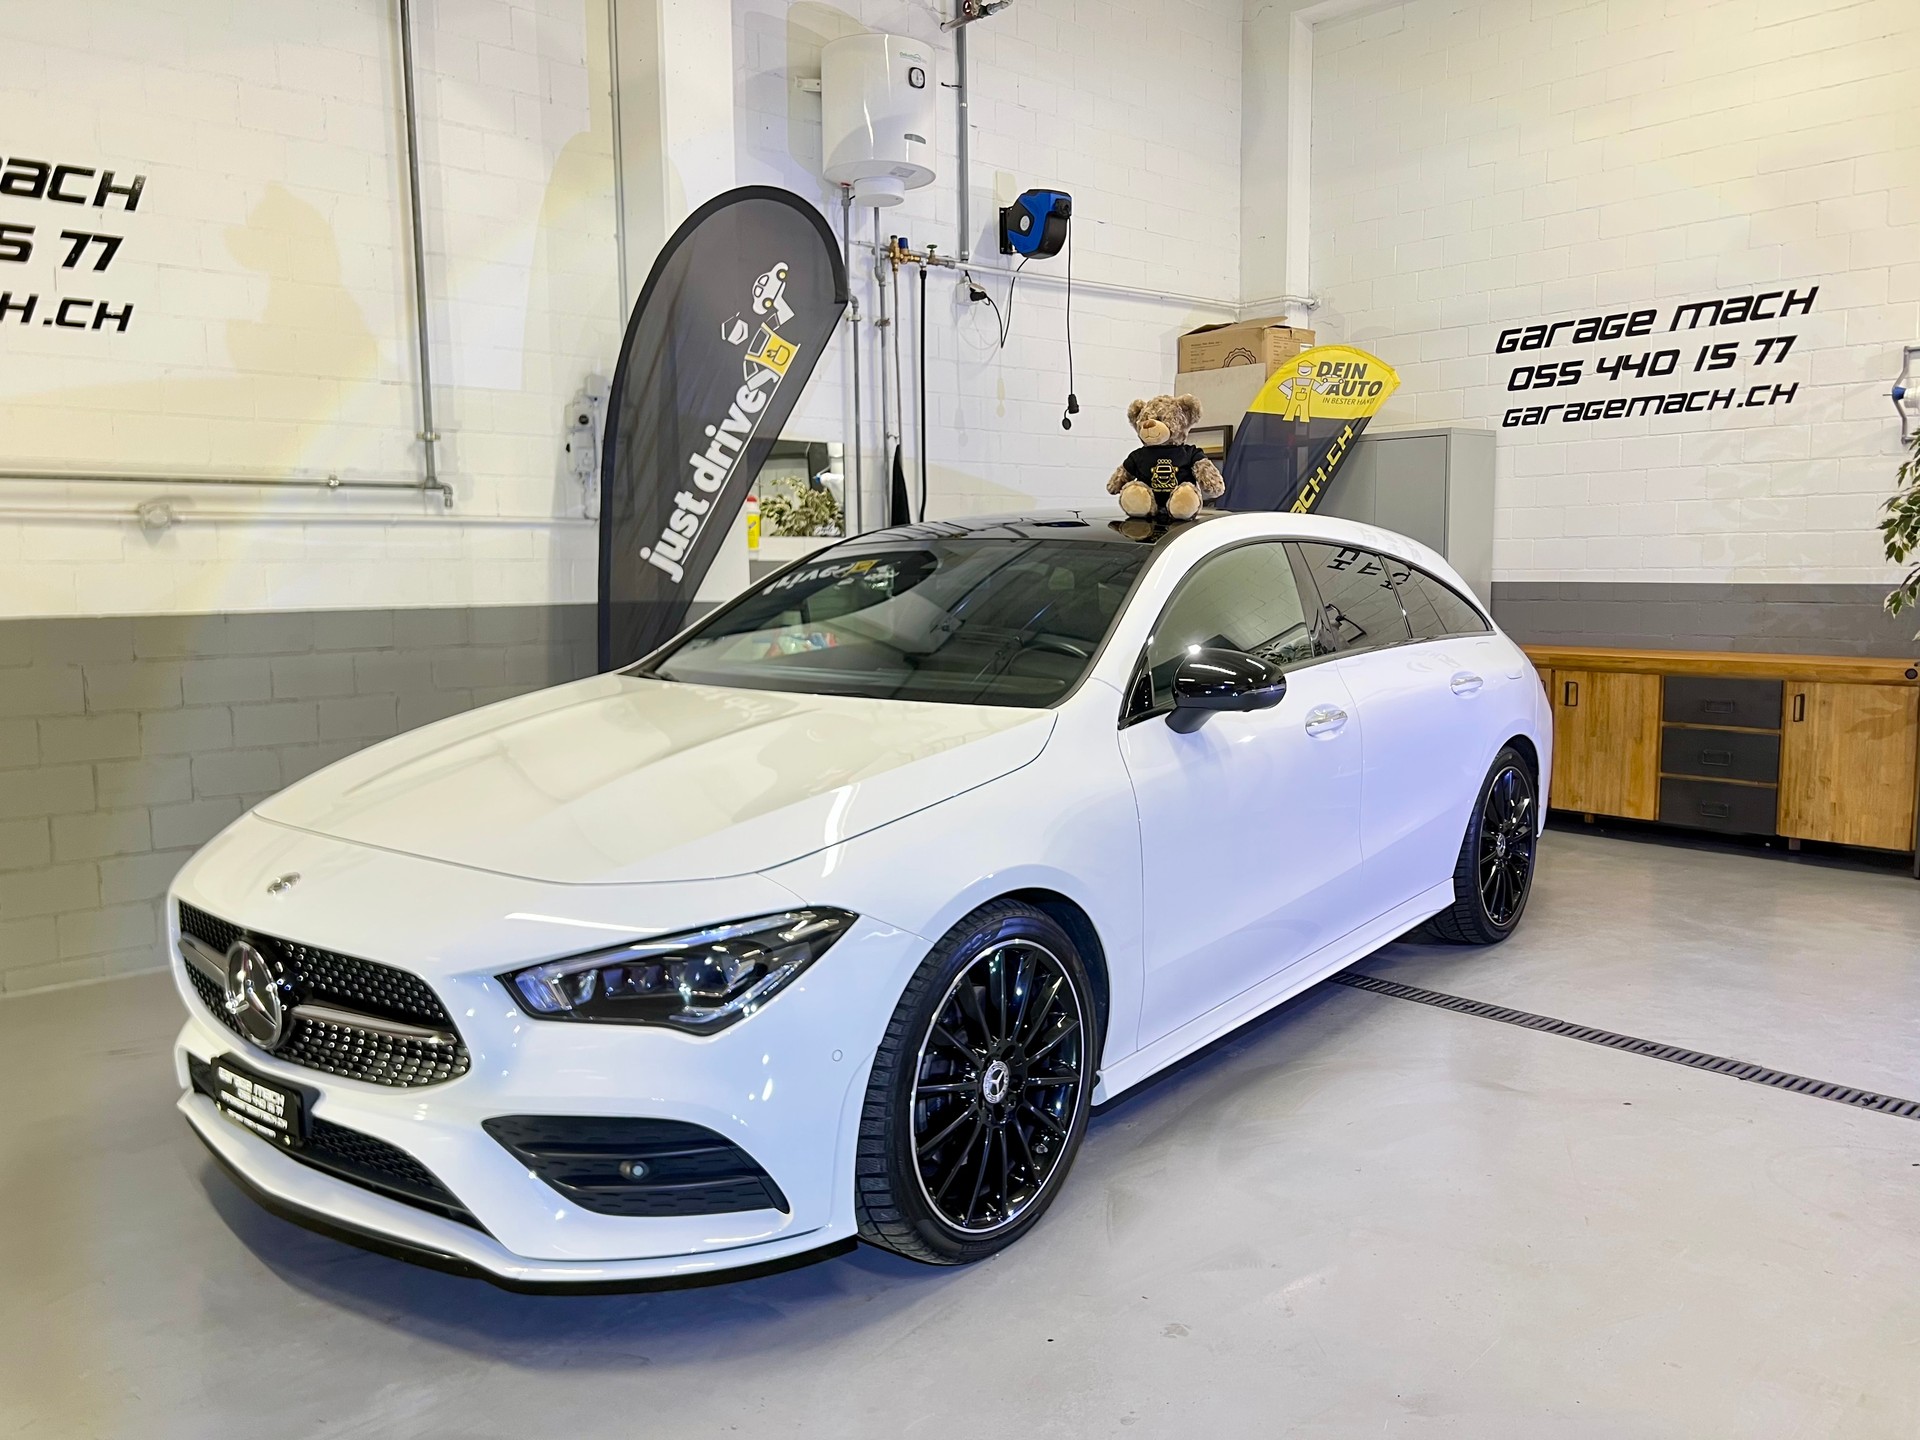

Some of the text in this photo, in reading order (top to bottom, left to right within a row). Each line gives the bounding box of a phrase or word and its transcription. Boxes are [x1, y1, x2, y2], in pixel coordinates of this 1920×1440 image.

[0, 157, 147, 212] ACH
[60, 229, 124, 272] 77
[1669, 286, 1819, 331] MACH
[1316, 362, 1368, 379] DEIN
[1507, 335, 1798, 391] 055 440 15 77
[1326, 381, 1383, 397] AUTO
[1331, 398, 1356, 406] BESTER
[640, 491, 710, 584] just
